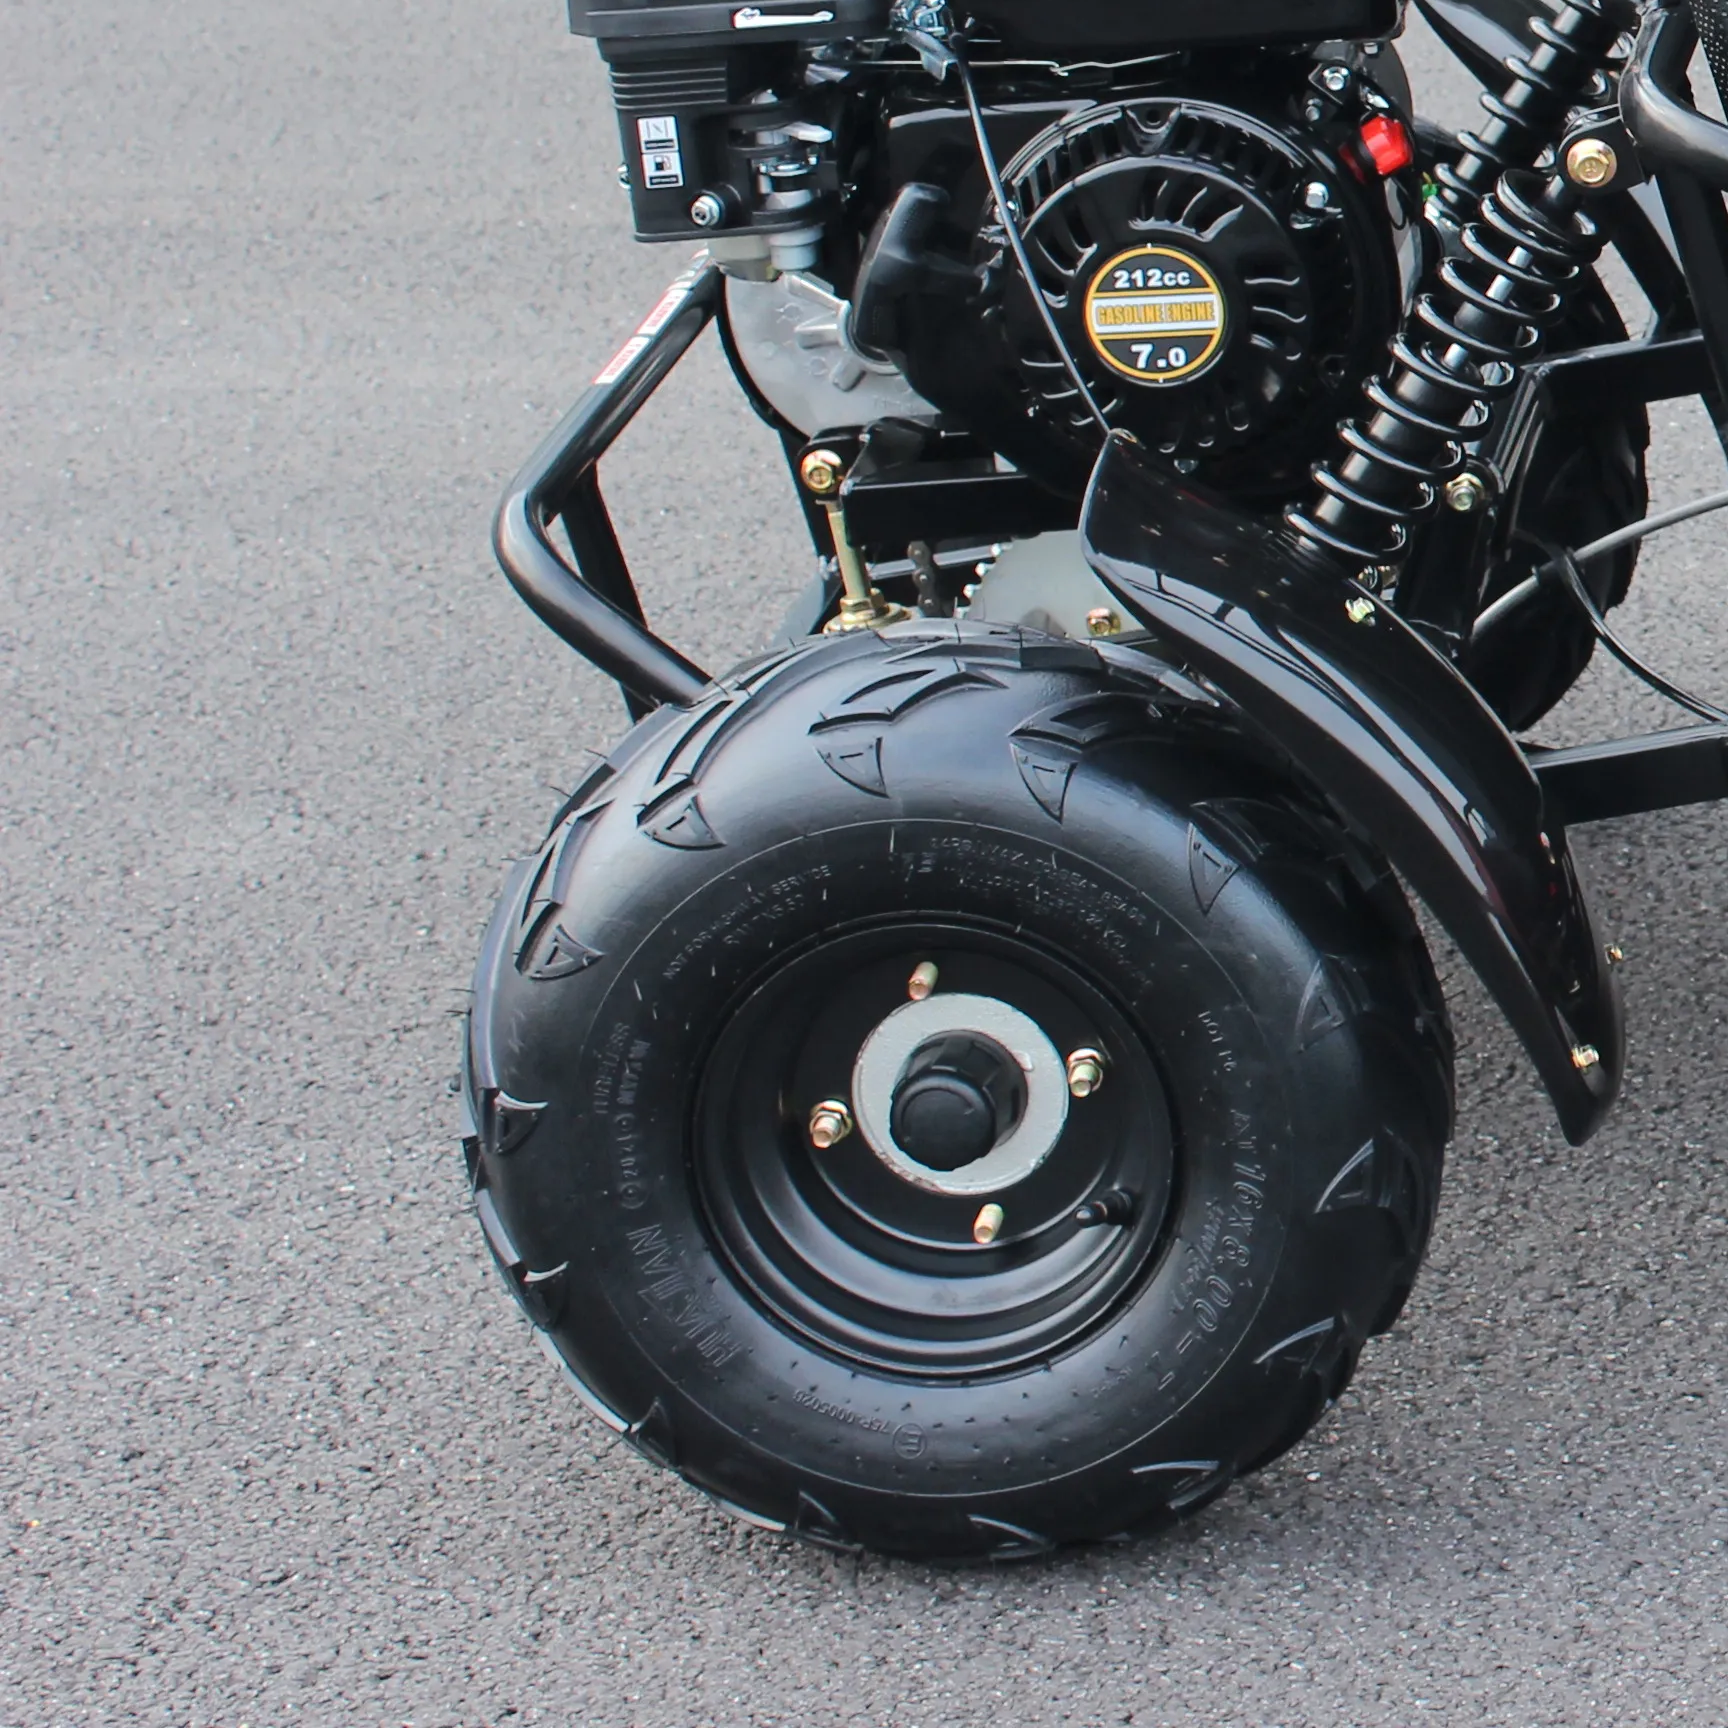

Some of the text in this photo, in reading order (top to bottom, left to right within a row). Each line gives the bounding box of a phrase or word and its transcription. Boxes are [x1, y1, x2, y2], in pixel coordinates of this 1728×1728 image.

[1113, 268, 1191, 289] 212cc
[1096, 301, 1215, 326] GASOLINE ENGINE
[1130, 343, 1186, 368] 7.0
[659, 949, 690, 983] NOT
[682, 925, 714, 958] FOR
[626, 1223, 744, 1367] HUAJIAN
